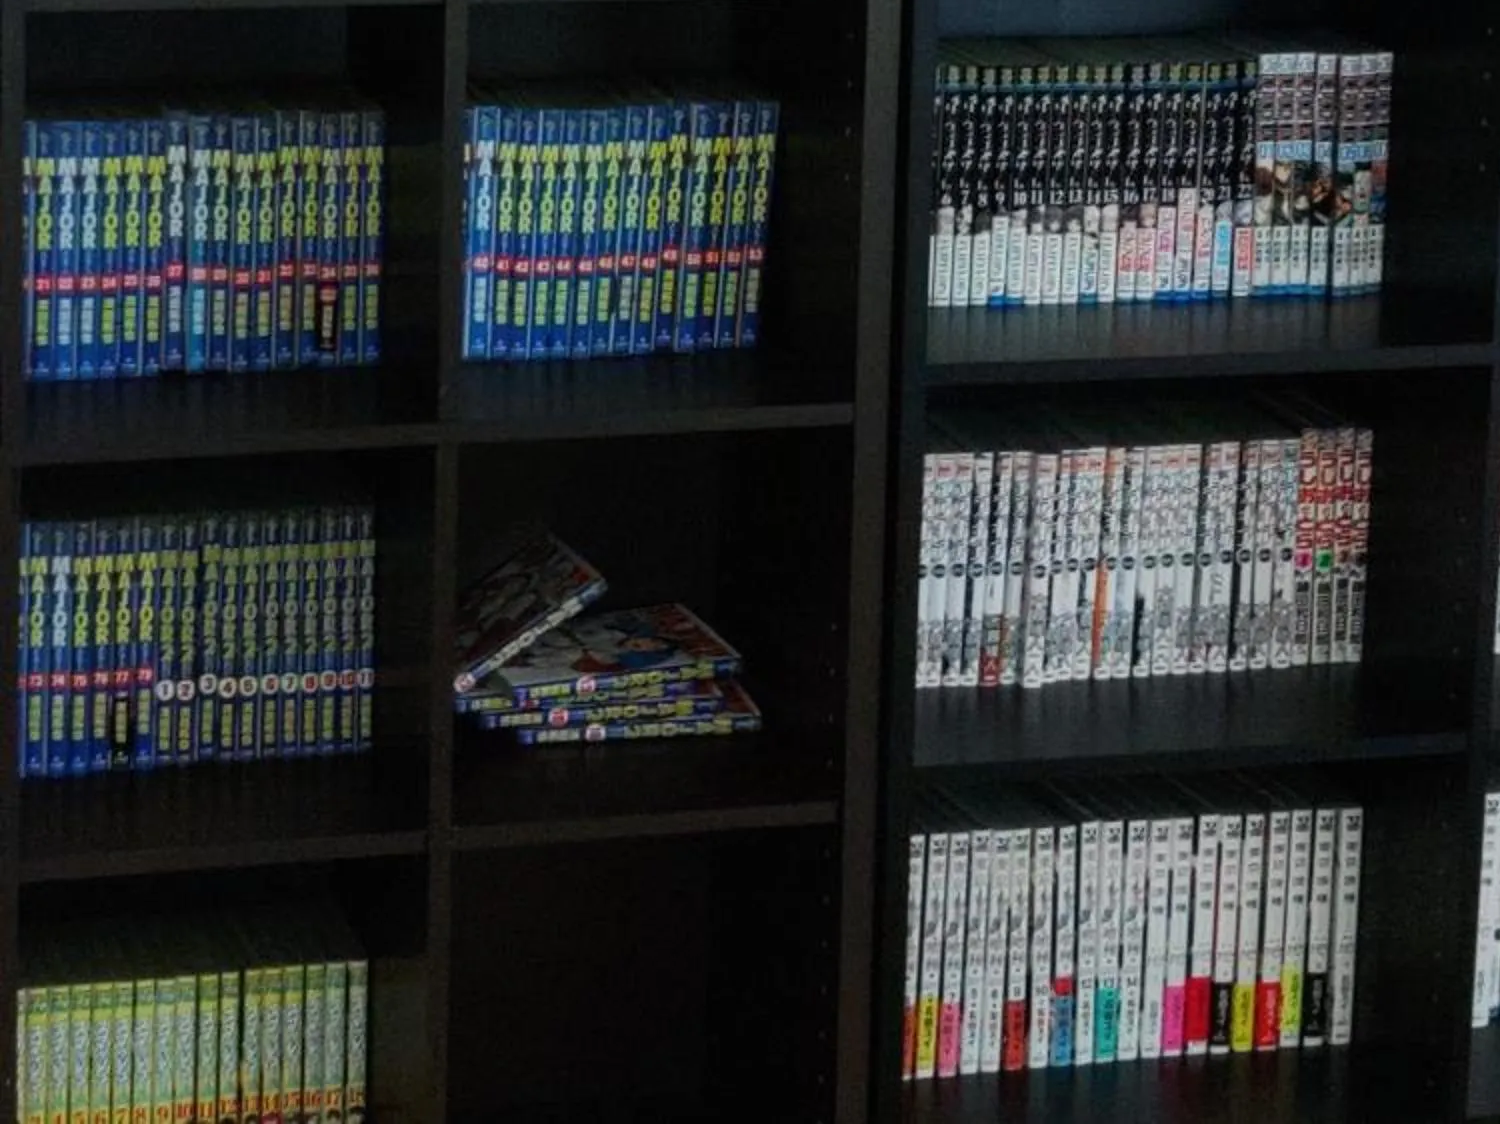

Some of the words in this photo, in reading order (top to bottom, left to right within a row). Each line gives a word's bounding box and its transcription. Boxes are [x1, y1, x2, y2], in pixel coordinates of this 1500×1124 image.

[36, 158, 55, 252] MAJOR
[58, 157, 77, 250] MAJOR
[82, 157, 100, 250] MAJOR
[103, 157, 121, 250] MAJOR
[125, 156, 143, 248] MAJOR
[147, 156, 166, 248] MAJOR
[167, 145, 186, 237] MAJOR
[193, 149, 211, 241] MAJOR
[213, 149, 231, 241] MAJOR
[236, 153, 254, 244] MAJOR
[258, 151, 276, 244] MAJOR
[280, 146, 299, 236] MAJOR
[303, 145, 321, 237] MAJOR
[323, 148, 340, 239] MAJOR
[344, 147, 361, 237] MAJOR
[366, 145, 384, 236] MAJOR
[476, 139, 494, 231] MAJOR
[499, 142, 517, 233] MAJOR
[518, 145, 537, 234] MAJOR
[540, 143, 559, 234] MAJOR
[560, 143, 580, 234] MAJOR
[582, 145, 602, 234] MAJOR
[603, 141, 622, 231] MAJOR
[625, 140, 645, 228] MAJOR
[646, 141, 666, 230] MAJOR
[667, 135, 687, 223] MAJOR
[691, 138, 712, 227] MAJOR
[710, 136, 731, 224] MAJOR
[732, 136, 752, 224] MAJOR
[753, 134, 776, 223] MAJOR
[30, 557, 48, 647] MAJOR
[52, 556, 71, 647] MAJOR
[74, 557, 91, 647] MAJOR
[95, 556, 113, 645] MAJOR
[115, 554, 134, 644] MAJOR
[139, 552, 157, 642] MAJOR
